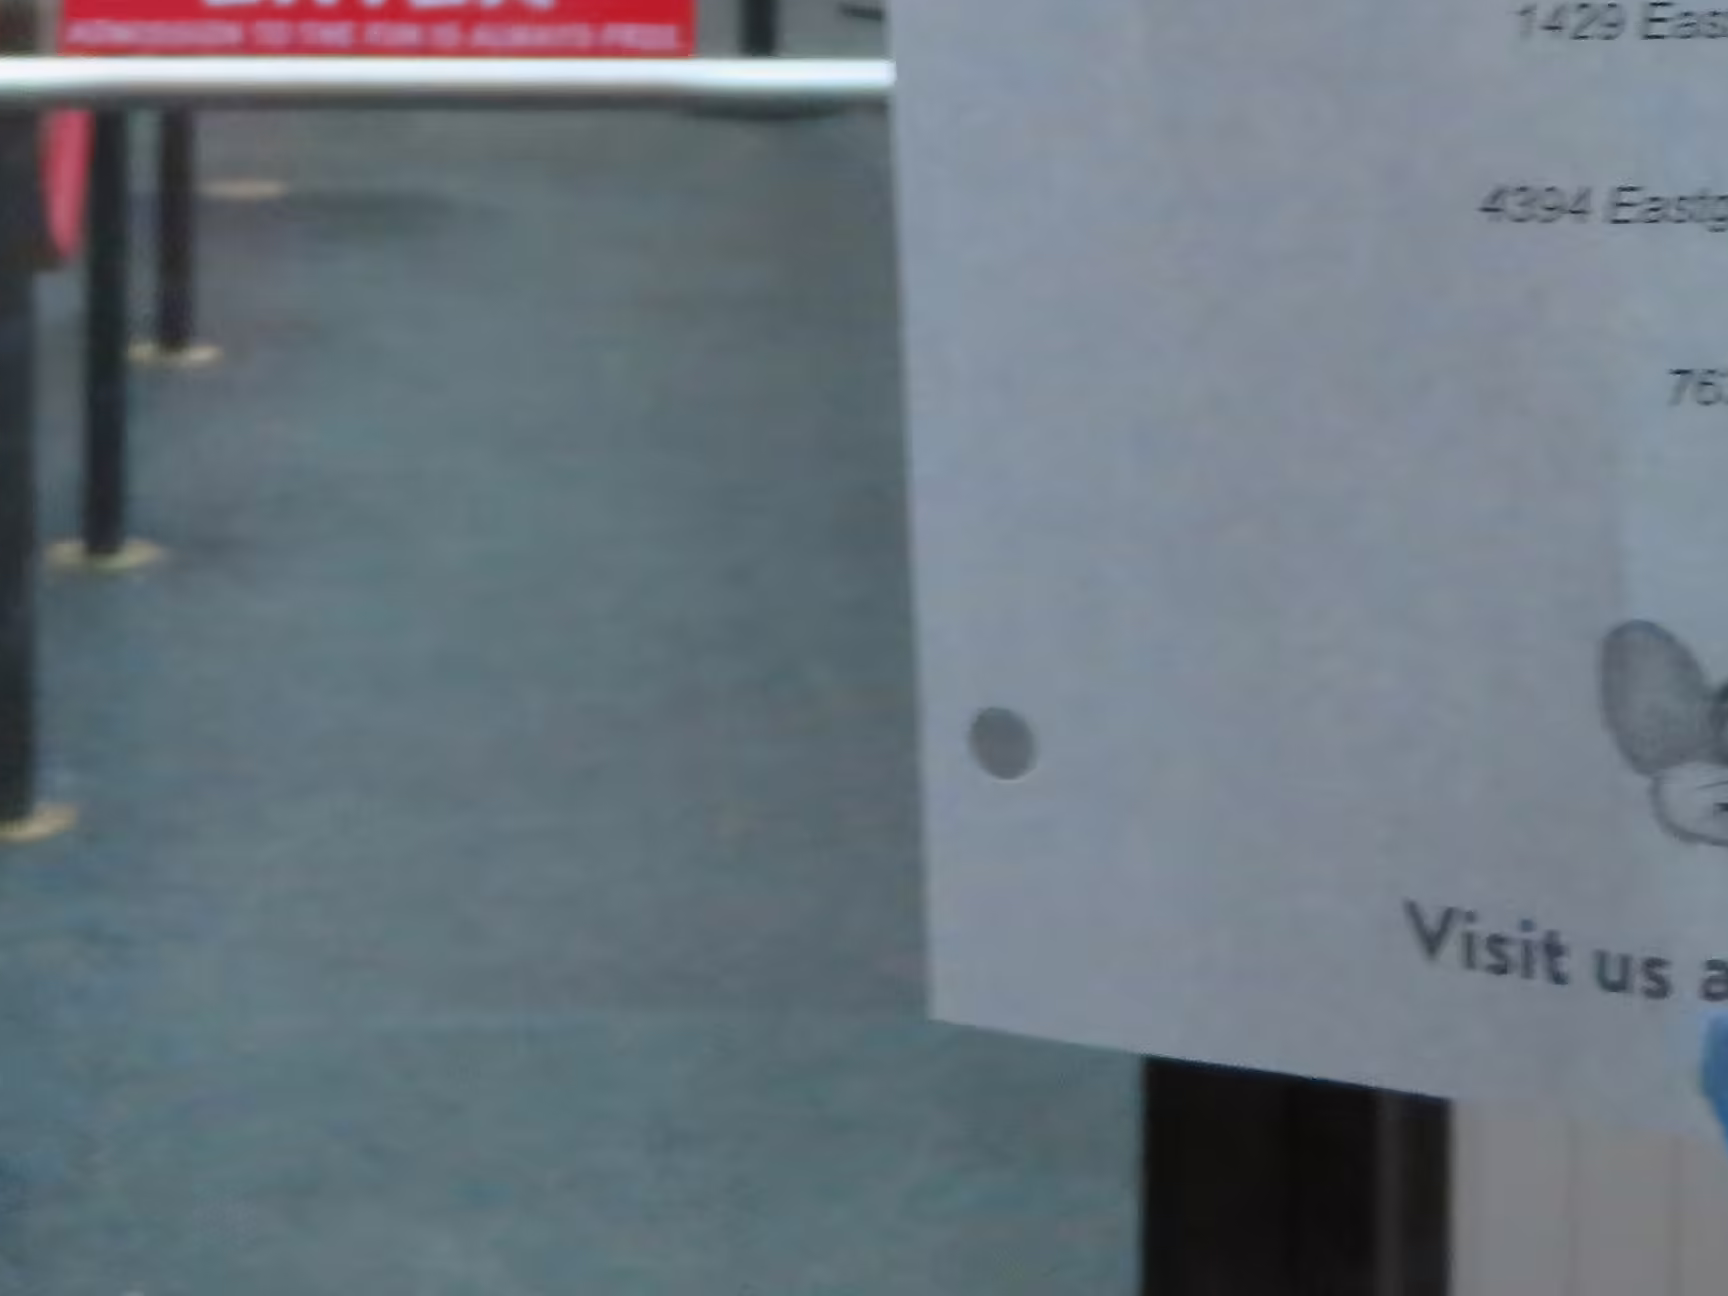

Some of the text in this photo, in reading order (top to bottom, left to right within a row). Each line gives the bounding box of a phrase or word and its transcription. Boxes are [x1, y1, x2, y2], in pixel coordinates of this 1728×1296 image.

[1517, 2, 1625, 42] 1429
[1479, 185, 1592, 225] 4394
[1402, 898, 1572, 986] Visit
[1591, 948, 1672, 1000] us
